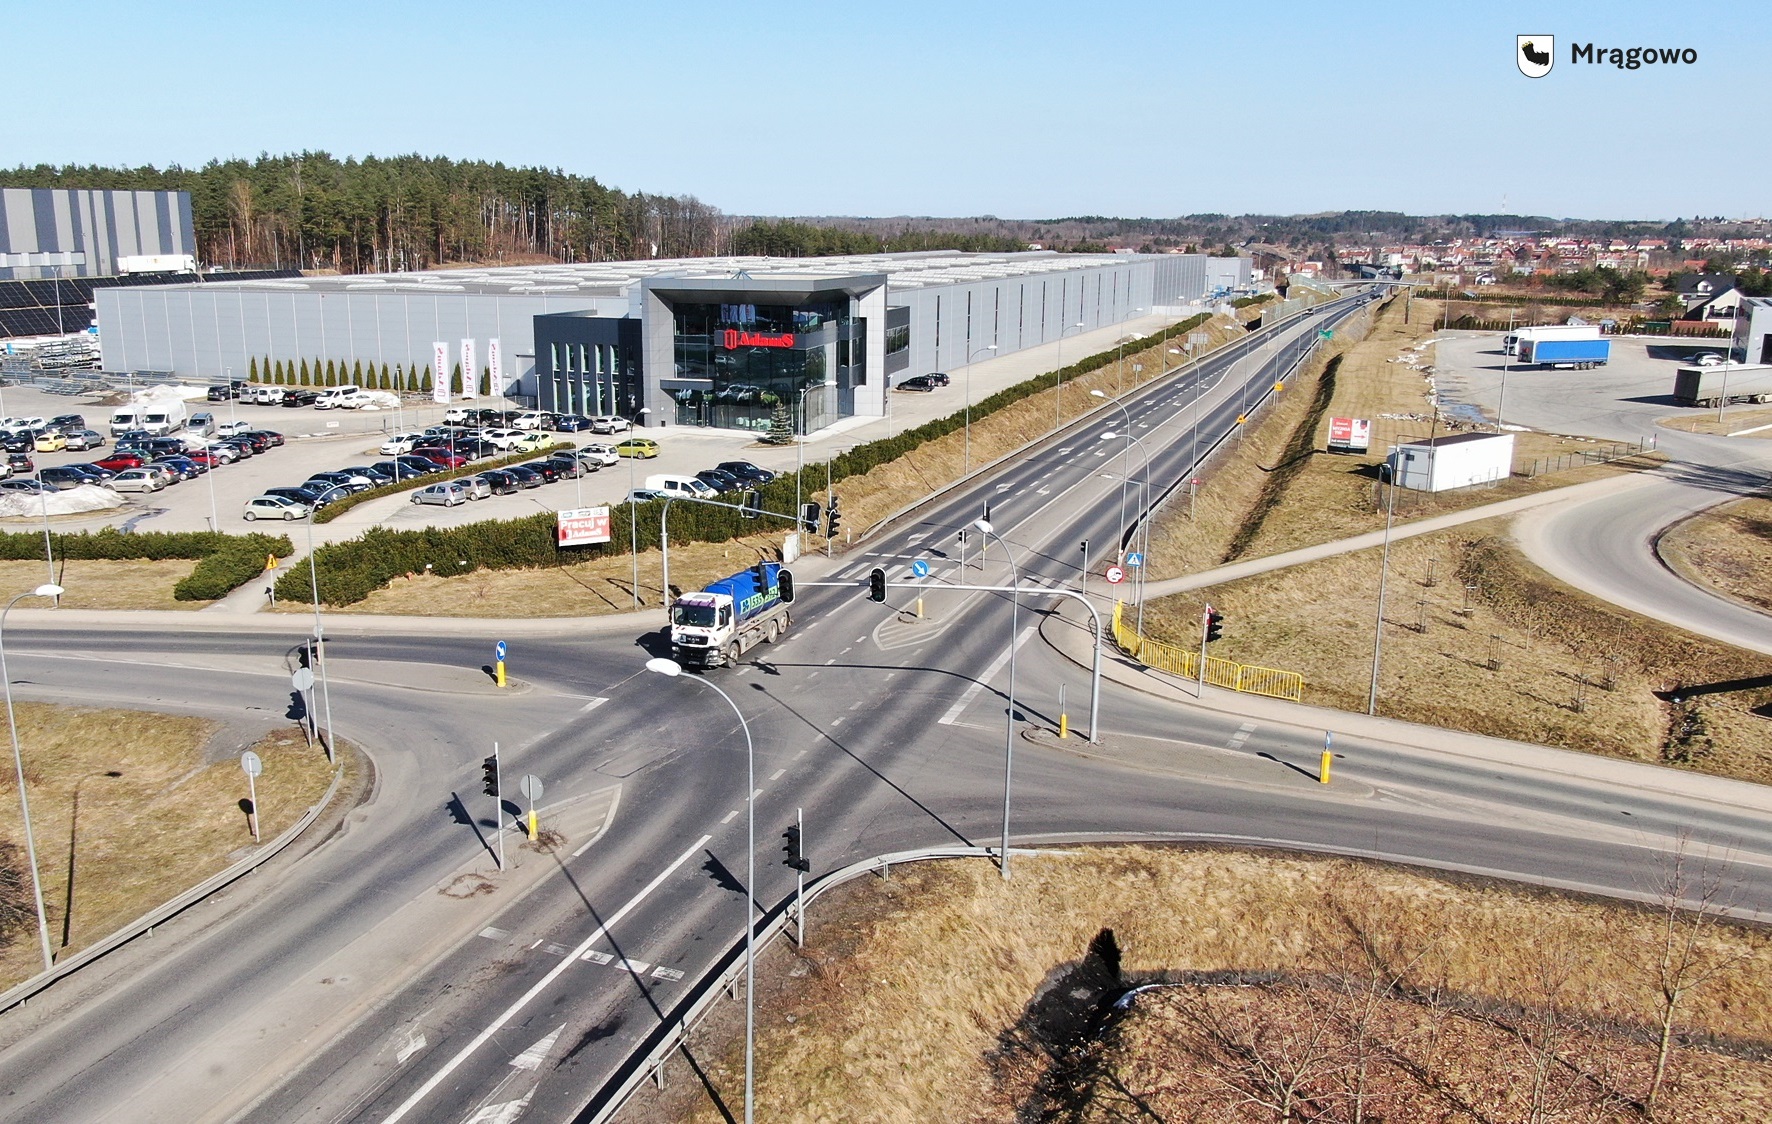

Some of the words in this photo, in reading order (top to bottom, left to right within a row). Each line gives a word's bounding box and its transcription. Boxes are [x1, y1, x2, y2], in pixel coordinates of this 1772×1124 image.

[738, 331, 794, 348] AdamS
[560, 517, 595, 530] Pracuj
[596, 518, 608, 526] w
